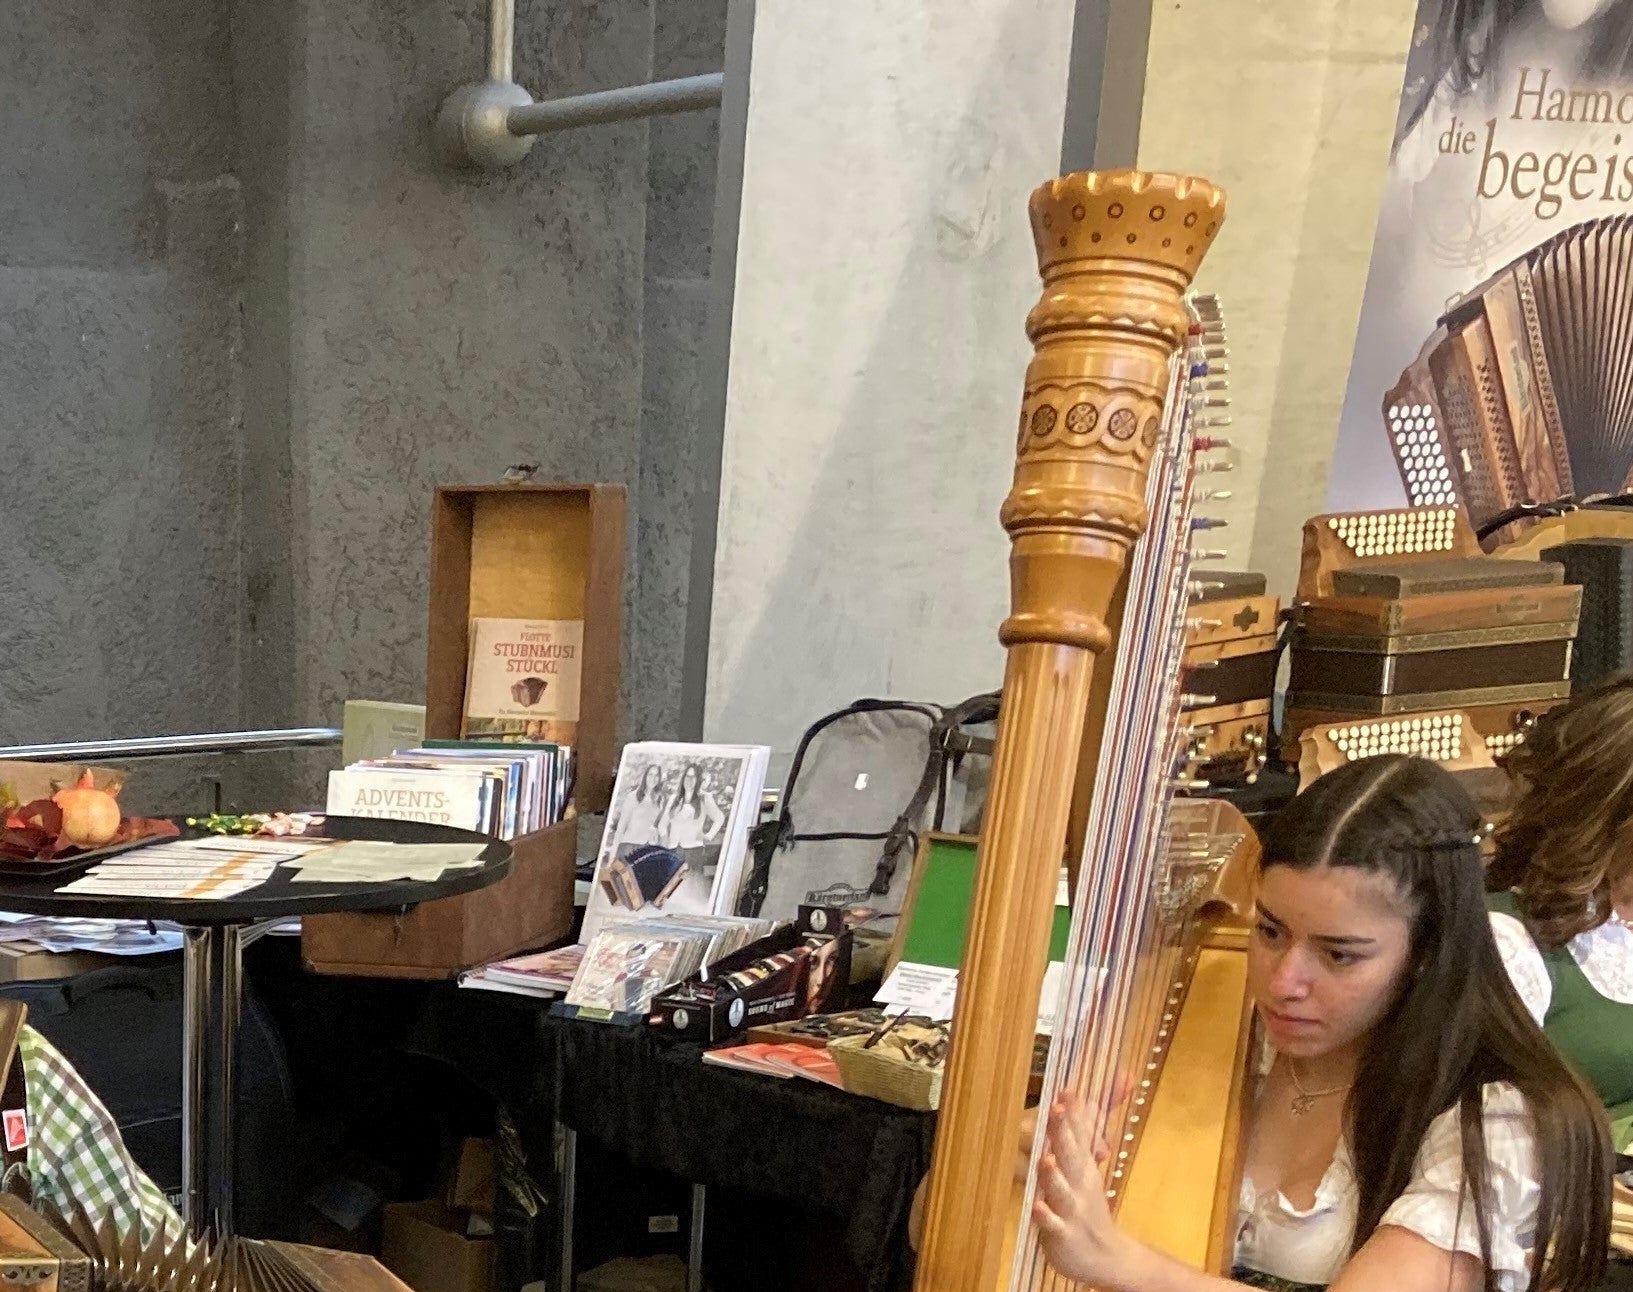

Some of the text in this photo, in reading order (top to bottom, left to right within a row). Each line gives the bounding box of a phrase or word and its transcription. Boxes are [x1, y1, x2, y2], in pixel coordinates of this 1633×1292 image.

[1510, 65, 1633, 124] Harmo
[1438, 116, 1633, 220] die begeis
[493, 642, 575, 659] STUBNMUSI
[354, 788, 450, 809] ADVENTS-
